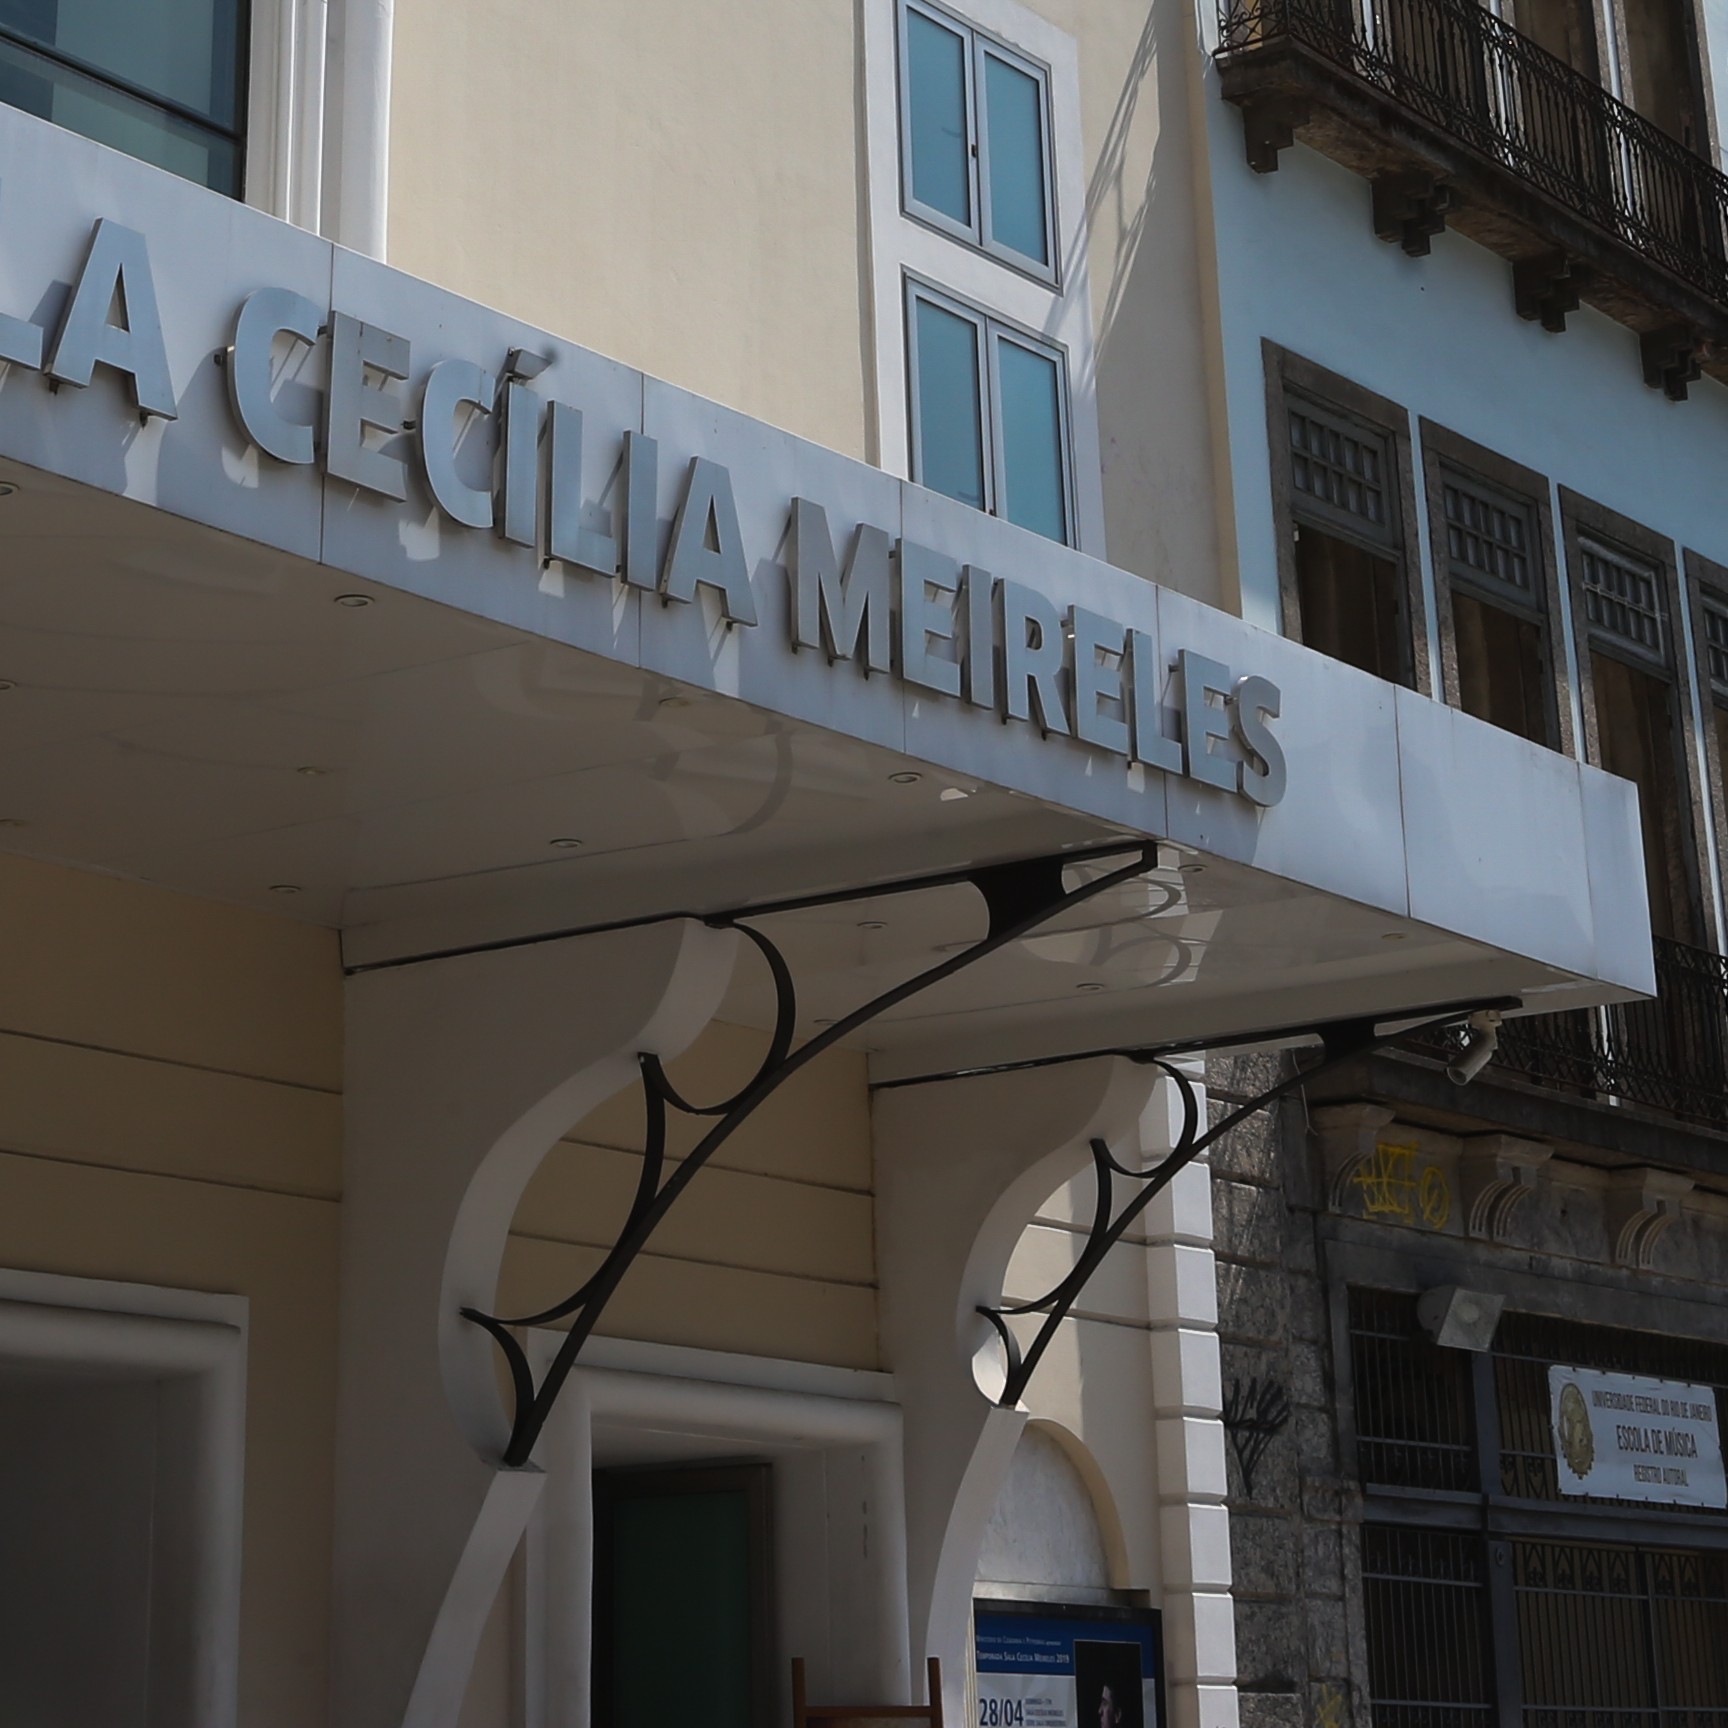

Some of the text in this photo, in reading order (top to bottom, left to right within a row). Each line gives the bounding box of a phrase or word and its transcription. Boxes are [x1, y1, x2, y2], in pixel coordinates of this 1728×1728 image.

[228, 286, 758, 627] CECÍLIA
[791, 497, 1287, 806] MEIRELES
[1592, 1390, 1634, 1412] UNIVERSIDADE
[1634, 1394, 1661, 1415] FEDERAL
[1616, 1424, 1698, 1458] ESCOLA DE MÚSICA
[979, 1698, 1023, 1727] 28/04
